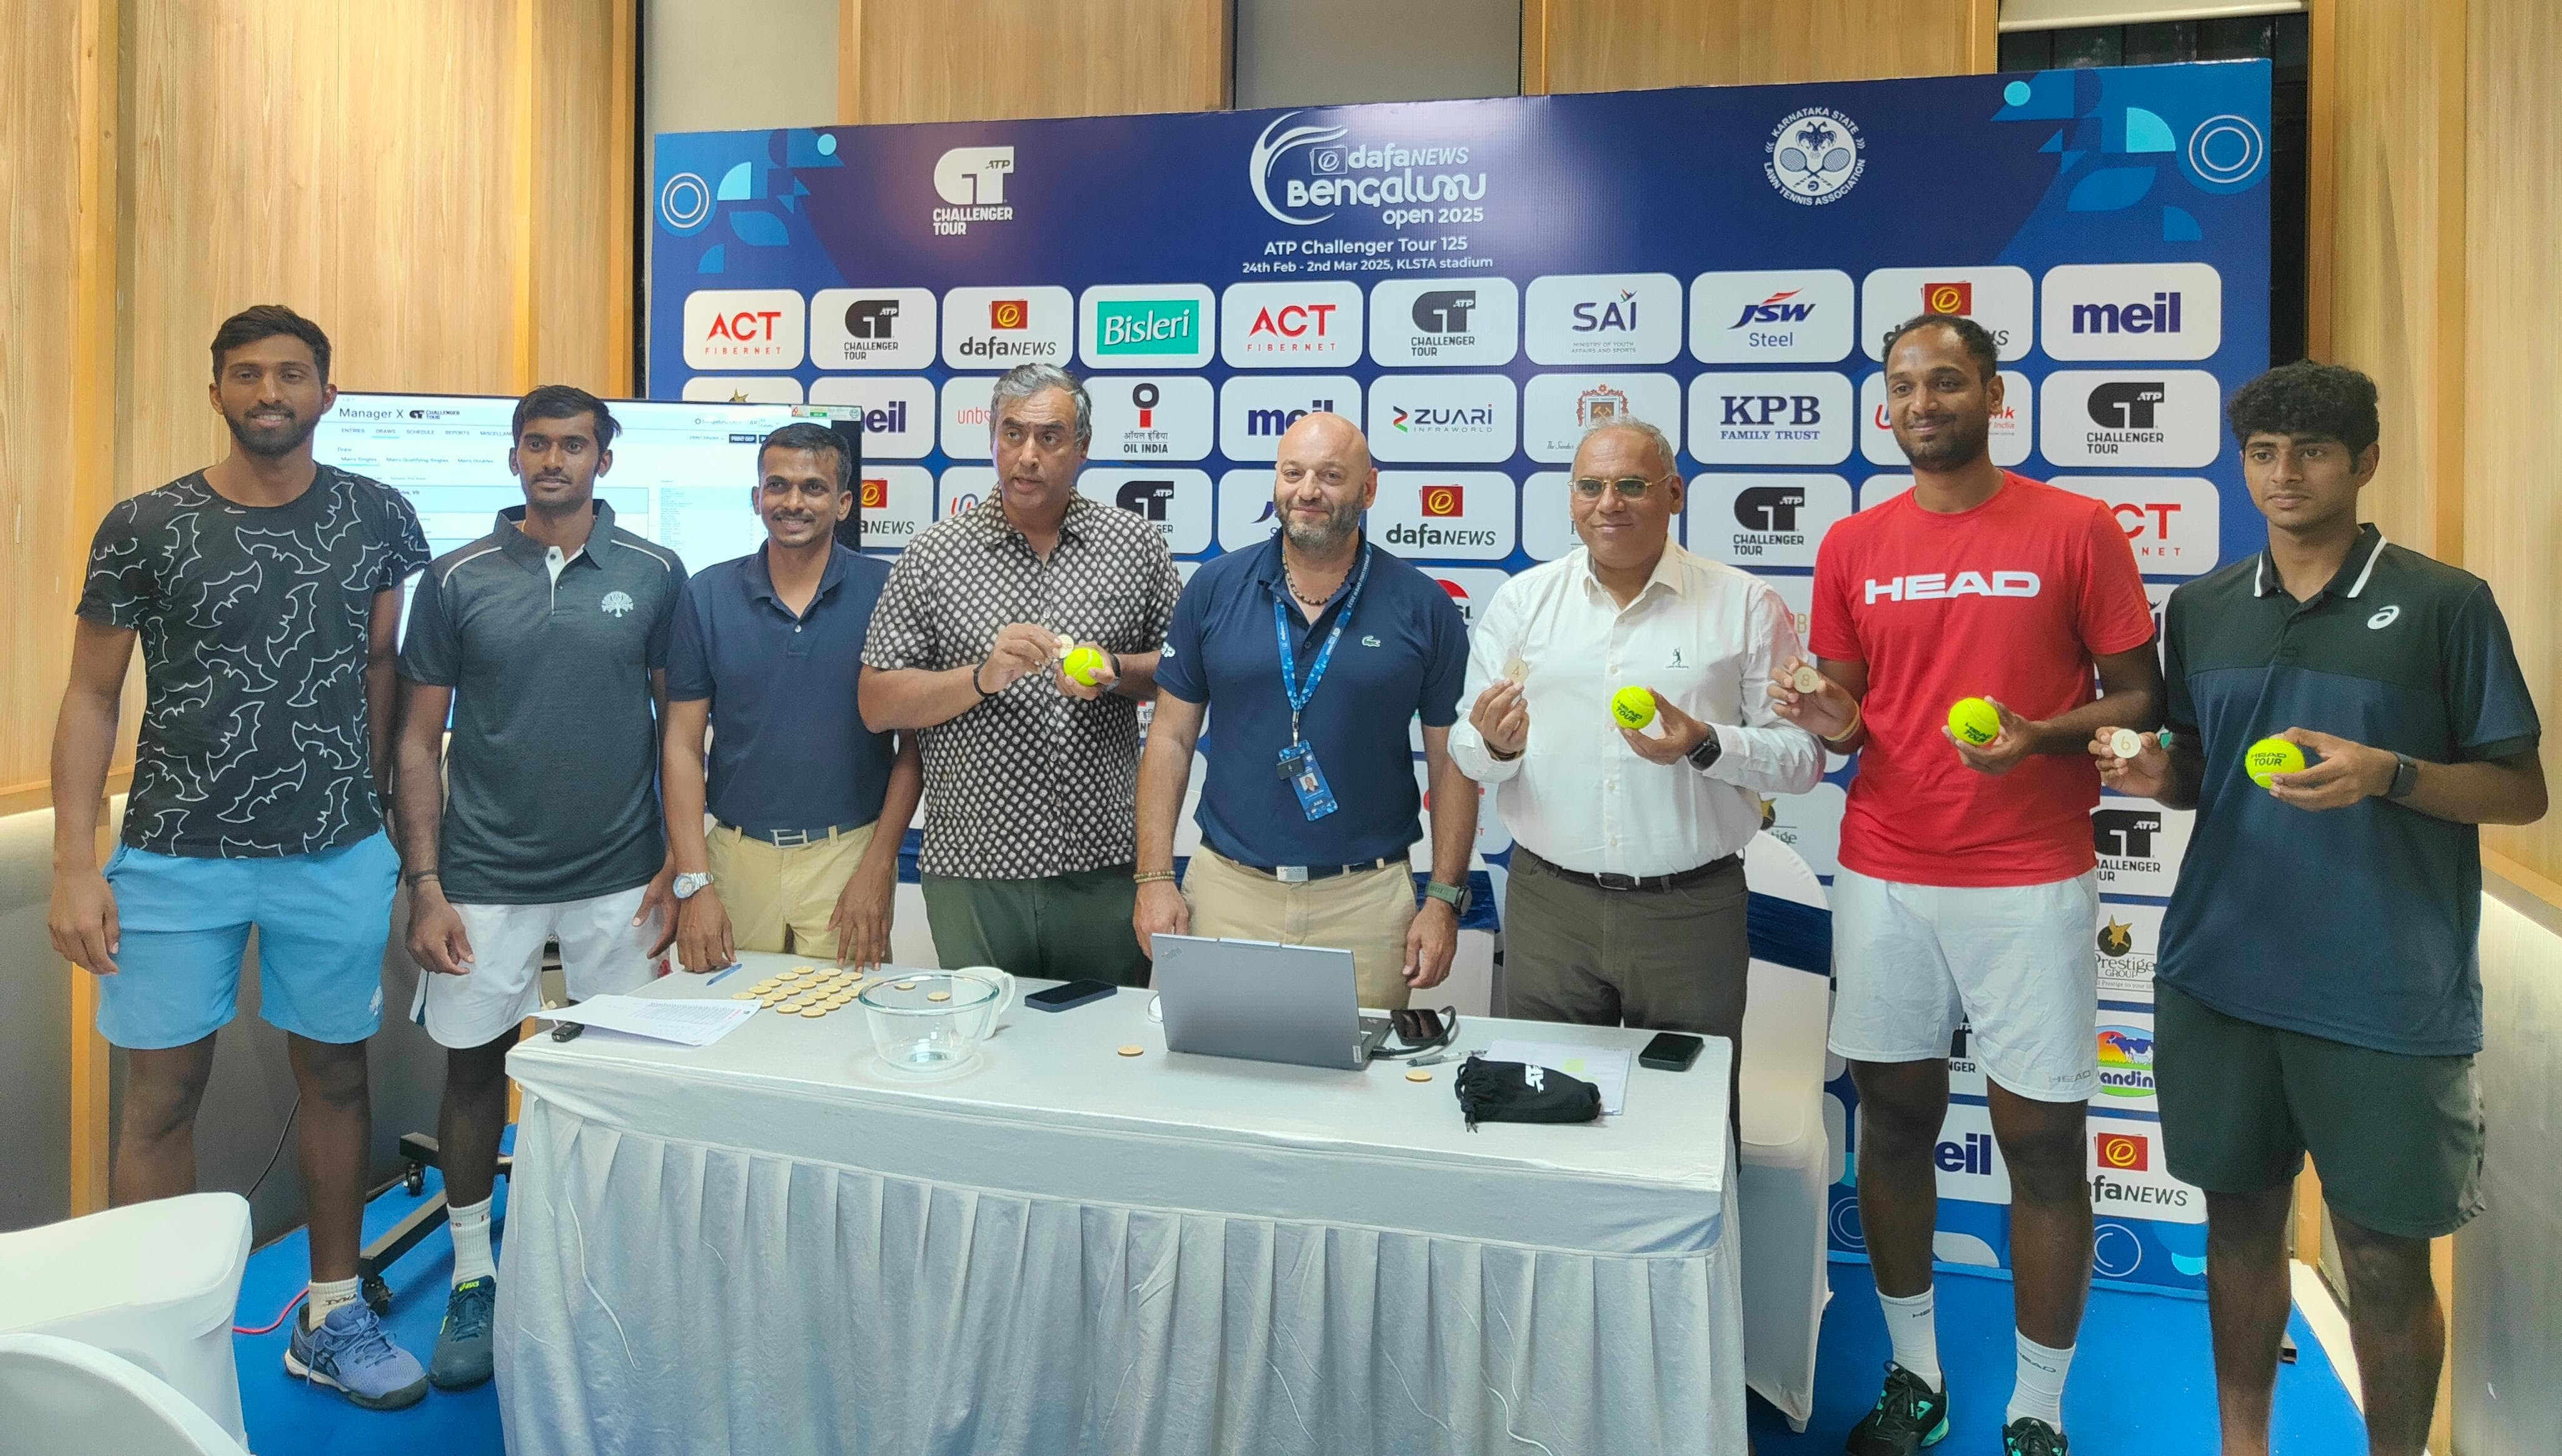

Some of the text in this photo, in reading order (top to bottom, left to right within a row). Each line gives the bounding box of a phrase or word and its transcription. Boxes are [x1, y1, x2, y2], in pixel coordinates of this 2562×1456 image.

[1771, 106, 1859, 138] KARNATAKA STATE
[986, 159, 1010, 169] ATP
[1348, 143, 1469, 173] dafaNEWS
[1764, 159, 1866, 206] LAWN TENNIS ASSOCIATION
[933, 206, 1013, 222] CHALLENGER
[1382, 206, 1484, 230] open 2025
[933, 220, 967, 236] TOUR
[1263, 236, 1468, 256] ATP Challenger Tour 125
[1242, 261, 1271, 273] 24th
[1273, 260, 1297, 273] Feb
[1307, 260, 1331, 272] 2nd
[1334, 259, 1358, 271] Mar
[1360, 258, 1394, 273] 2025,
[1396, 257, 1437, 270] KLSTA
[1439, 256, 1493, 269] stadium
[1453, 299, 1475, 308] ATP
[879, 307, 898, 316] ATP
[1572, 301, 1638, 333] SAI
[1728, 303, 1816, 330] JSW
[2072, 292, 2182, 334] meil
[706, 311, 781, 342] ACT
[1248, 304, 1336, 337] ACT
[1103, 309, 1190, 346] Bisleri
[844, 341, 899, 351] CHALLENGER
[1410, 336, 1476, 346] CHALLENGER
[1749, 332, 1794, 347] Steel
[705, 346, 782, 355] FIBERNET
[959, 336, 1057, 361] dafaNEWS
[1247, 343, 1337, 352] FIBERNET
[1410, 346, 1438, 356] TOUR
[844, 351, 868, 361] TOUR
[2137, 391, 2162, 402] ATP
[339, 408, 404, 420] Manager X
[862, 401, 907, 433] eil
[1720, 395, 1821, 426] KPB
[1721, 430, 1821, 440] FAMILY TRUST
[2087, 432, 2164, 443] CHALLENGER
[1123, 443, 1168, 454] OIL INDIA
[2087, 443, 2119, 455] TOUR
[1153, 488, 1173, 498] ATP
[1780, 495, 1803, 505] ATP
[2112, 503, 2181, 540] CT
[1385, 522, 1497, 549] dafaNEWS
[1733, 533, 1805, 546] CHALLENGER
[1733, 545, 1763, 556] TOUR
[1865, 570, 2041, 605] HEAD
[1511, 665, 1521, 678] 4
[1801, 674, 1810, 687] 8
[1616, 705, 1638, 724] TOUR
[2254, 757, 2283, 767] TOUR
[2134, 821, 2160, 831] ATP
[2105, 969, 2138, 979] GROUP
[2102, 980, 2124, 988] Prestige
[2048, 1069, 2091, 1083] HEAD
[2100, 1070, 2154, 1088] andin
[1934, 1133, 1992, 1176] eil
